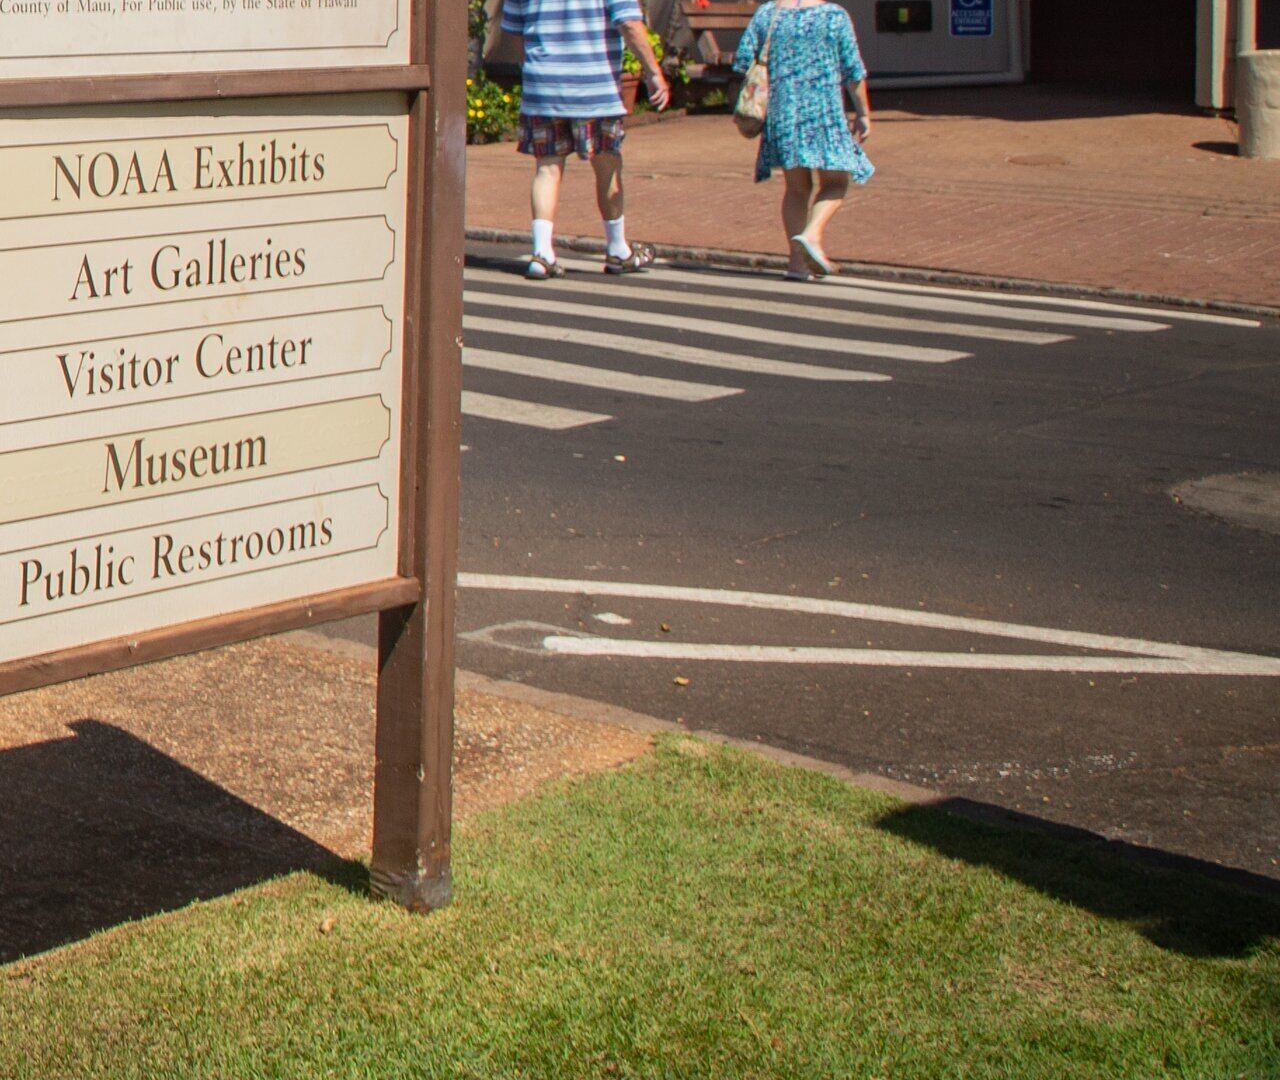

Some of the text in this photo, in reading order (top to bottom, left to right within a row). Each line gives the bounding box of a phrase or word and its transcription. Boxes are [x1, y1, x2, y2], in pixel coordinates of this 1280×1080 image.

[50, 138, 326, 202] NOAA Exhibits
[68, 237, 307, 301] Art Galleries
[55, 333, 313, 400] Visitor Center
[101, 432, 269, 494] Museum
[18, 515, 334, 607] Public Restrooms
